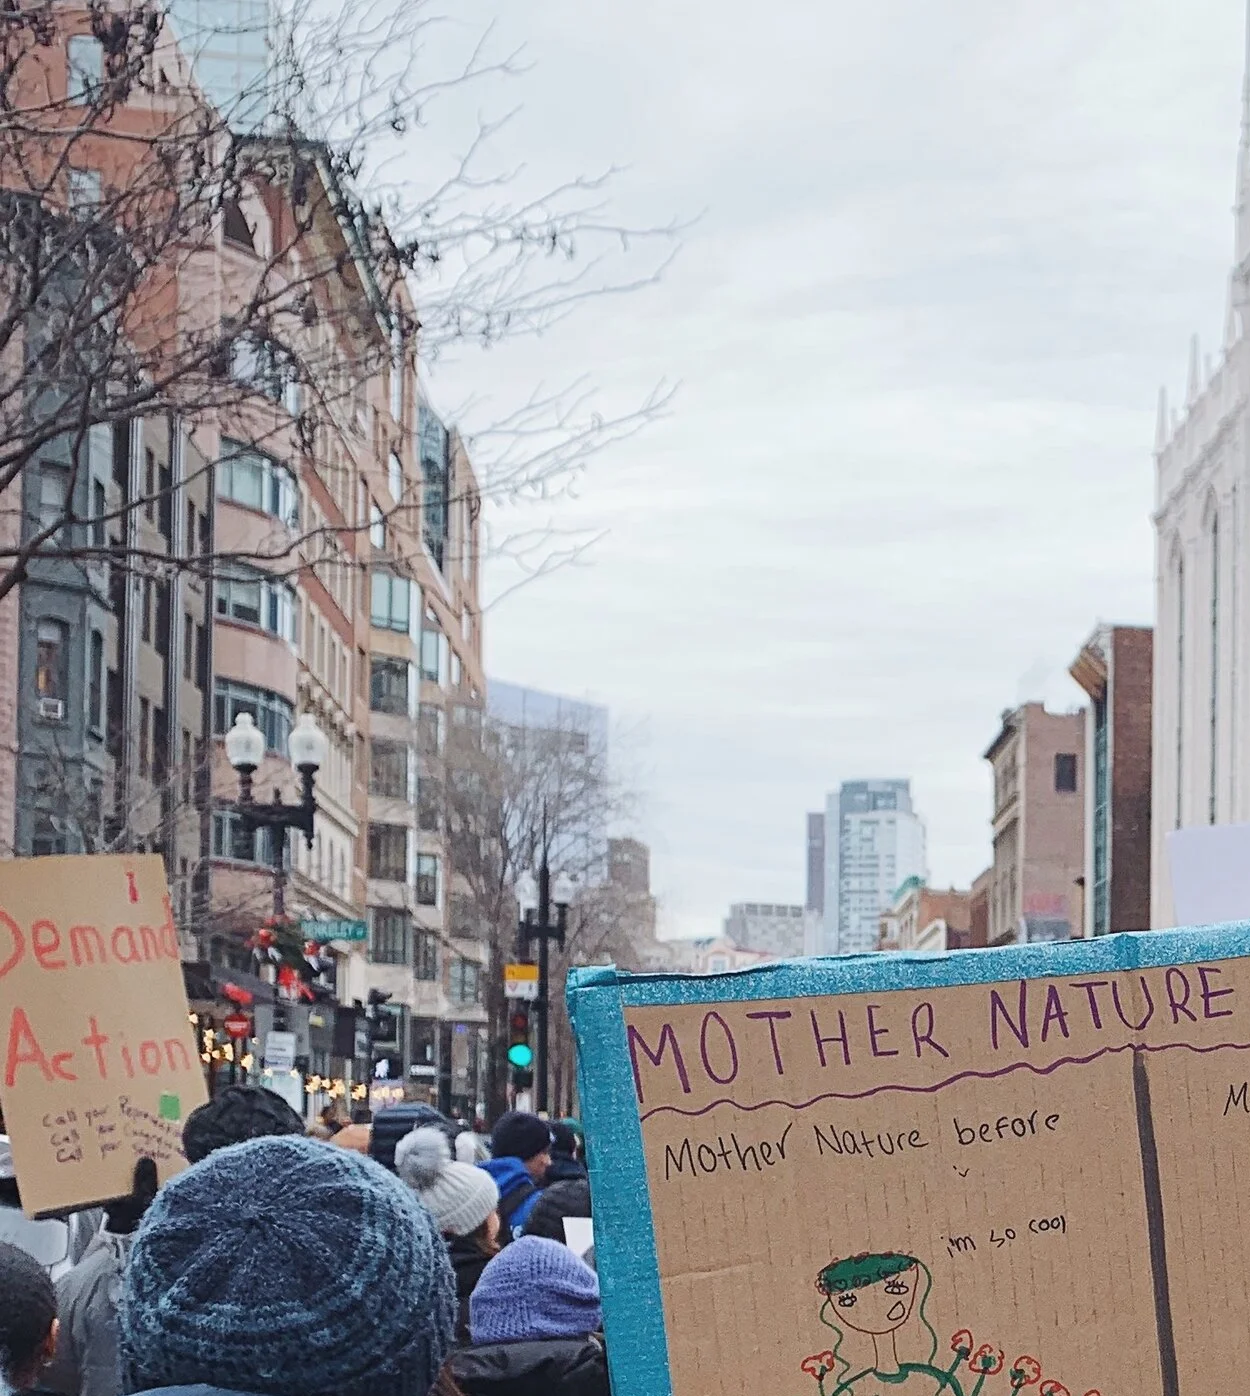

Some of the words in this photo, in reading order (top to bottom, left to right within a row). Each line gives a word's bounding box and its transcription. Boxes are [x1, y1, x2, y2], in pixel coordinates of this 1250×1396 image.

[4, 1006, 191, 1088] Action
[627, 1002, 949, 1104] MOTHER
[990, 966, 1234, 1049] NATURE
[664, 1122, 794, 1181] Mother
[813, 1125, 930, 1159] Nature
[953, 1110, 1061, 1147] before
[989, 1228, 1017, 1249] so
[1028, 1215, 1067, 1234] cool
